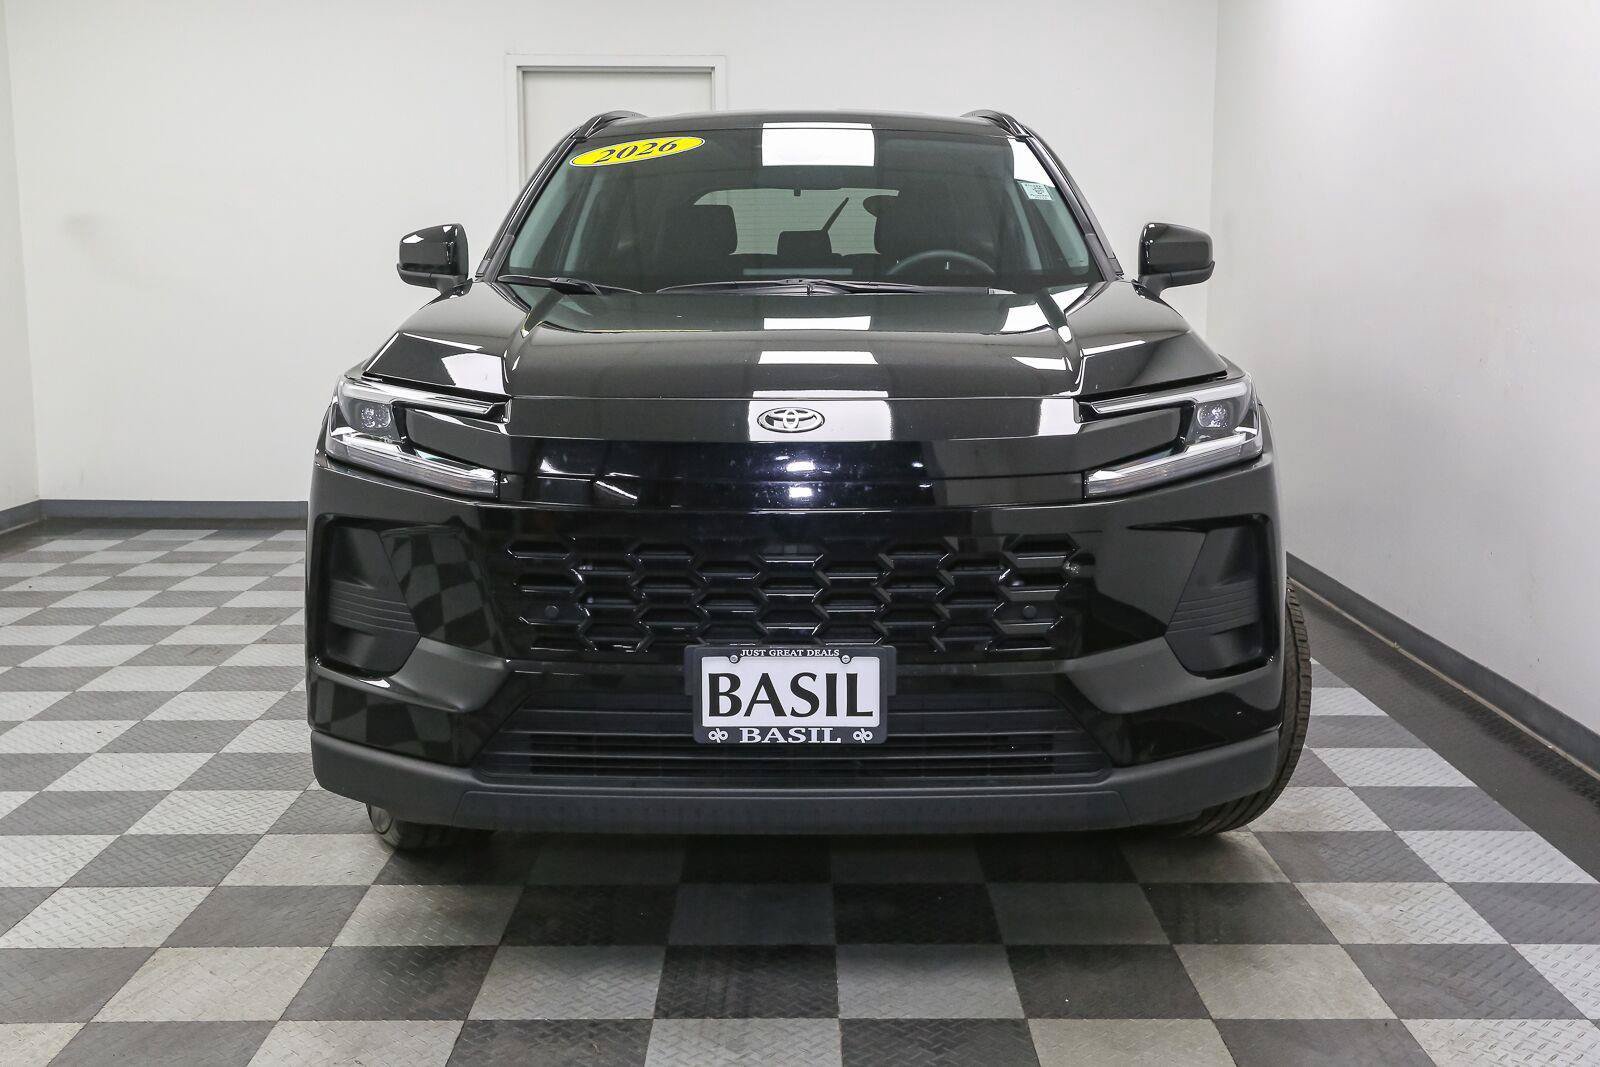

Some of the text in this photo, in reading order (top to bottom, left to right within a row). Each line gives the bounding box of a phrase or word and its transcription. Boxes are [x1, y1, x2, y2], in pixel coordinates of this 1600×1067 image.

[593, 139, 680, 163] 2026
[740, 649, 840, 657] JUST GREAT DEALS
[708, 672, 873, 718] BASIL
[739, 727, 842, 744] BASIL
